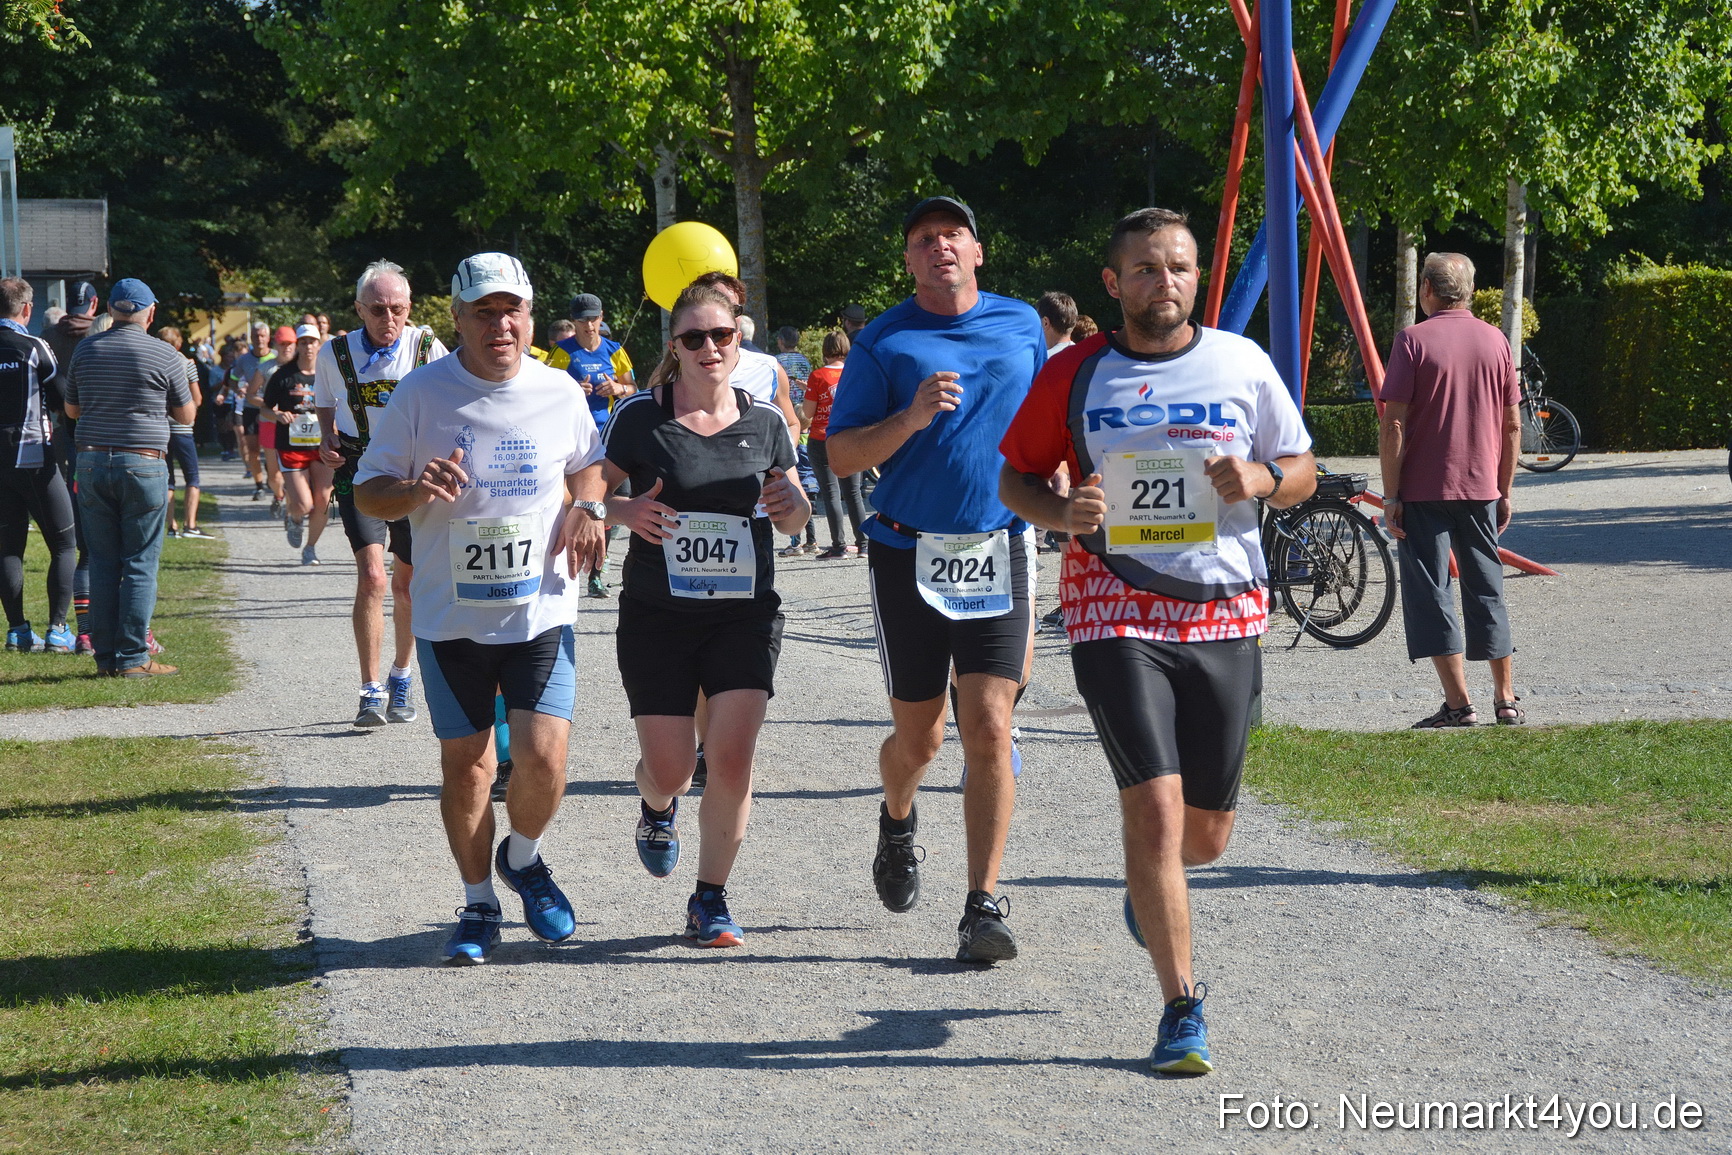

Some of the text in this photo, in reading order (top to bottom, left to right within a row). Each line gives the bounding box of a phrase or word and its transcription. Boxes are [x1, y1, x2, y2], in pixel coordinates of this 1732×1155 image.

[301, 423, 314, 433] 97
[1167, 423, 1235, 442] energie
[493, 452, 538, 461] 16.09.2007
[1136, 458, 1184, 471] BOCK
[476, 478, 538, 488] Neumarkter
[490, 486, 538, 497] Stadtlauf
[1131, 477, 1185, 509] 221
[479, 523, 520, 536] BOCK
[689, 520, 728, 531] BOCK
[1140, 527, 1184, 541] Marcel
[676, 536, 739, 563] 3047
[944, 541, 983, 551] BOCK
[465, 539, 532, 571] 2117
[494, 572, 523, 580] Neumarkt
[930, 556, 996, 583] 2024
[487, 584, 518, 598] Josef
[944, 598, 986, 610] Norbert
[1085, 597, 1142, 622] AVIA
[1212, 592, 1262, 620] AVIA
